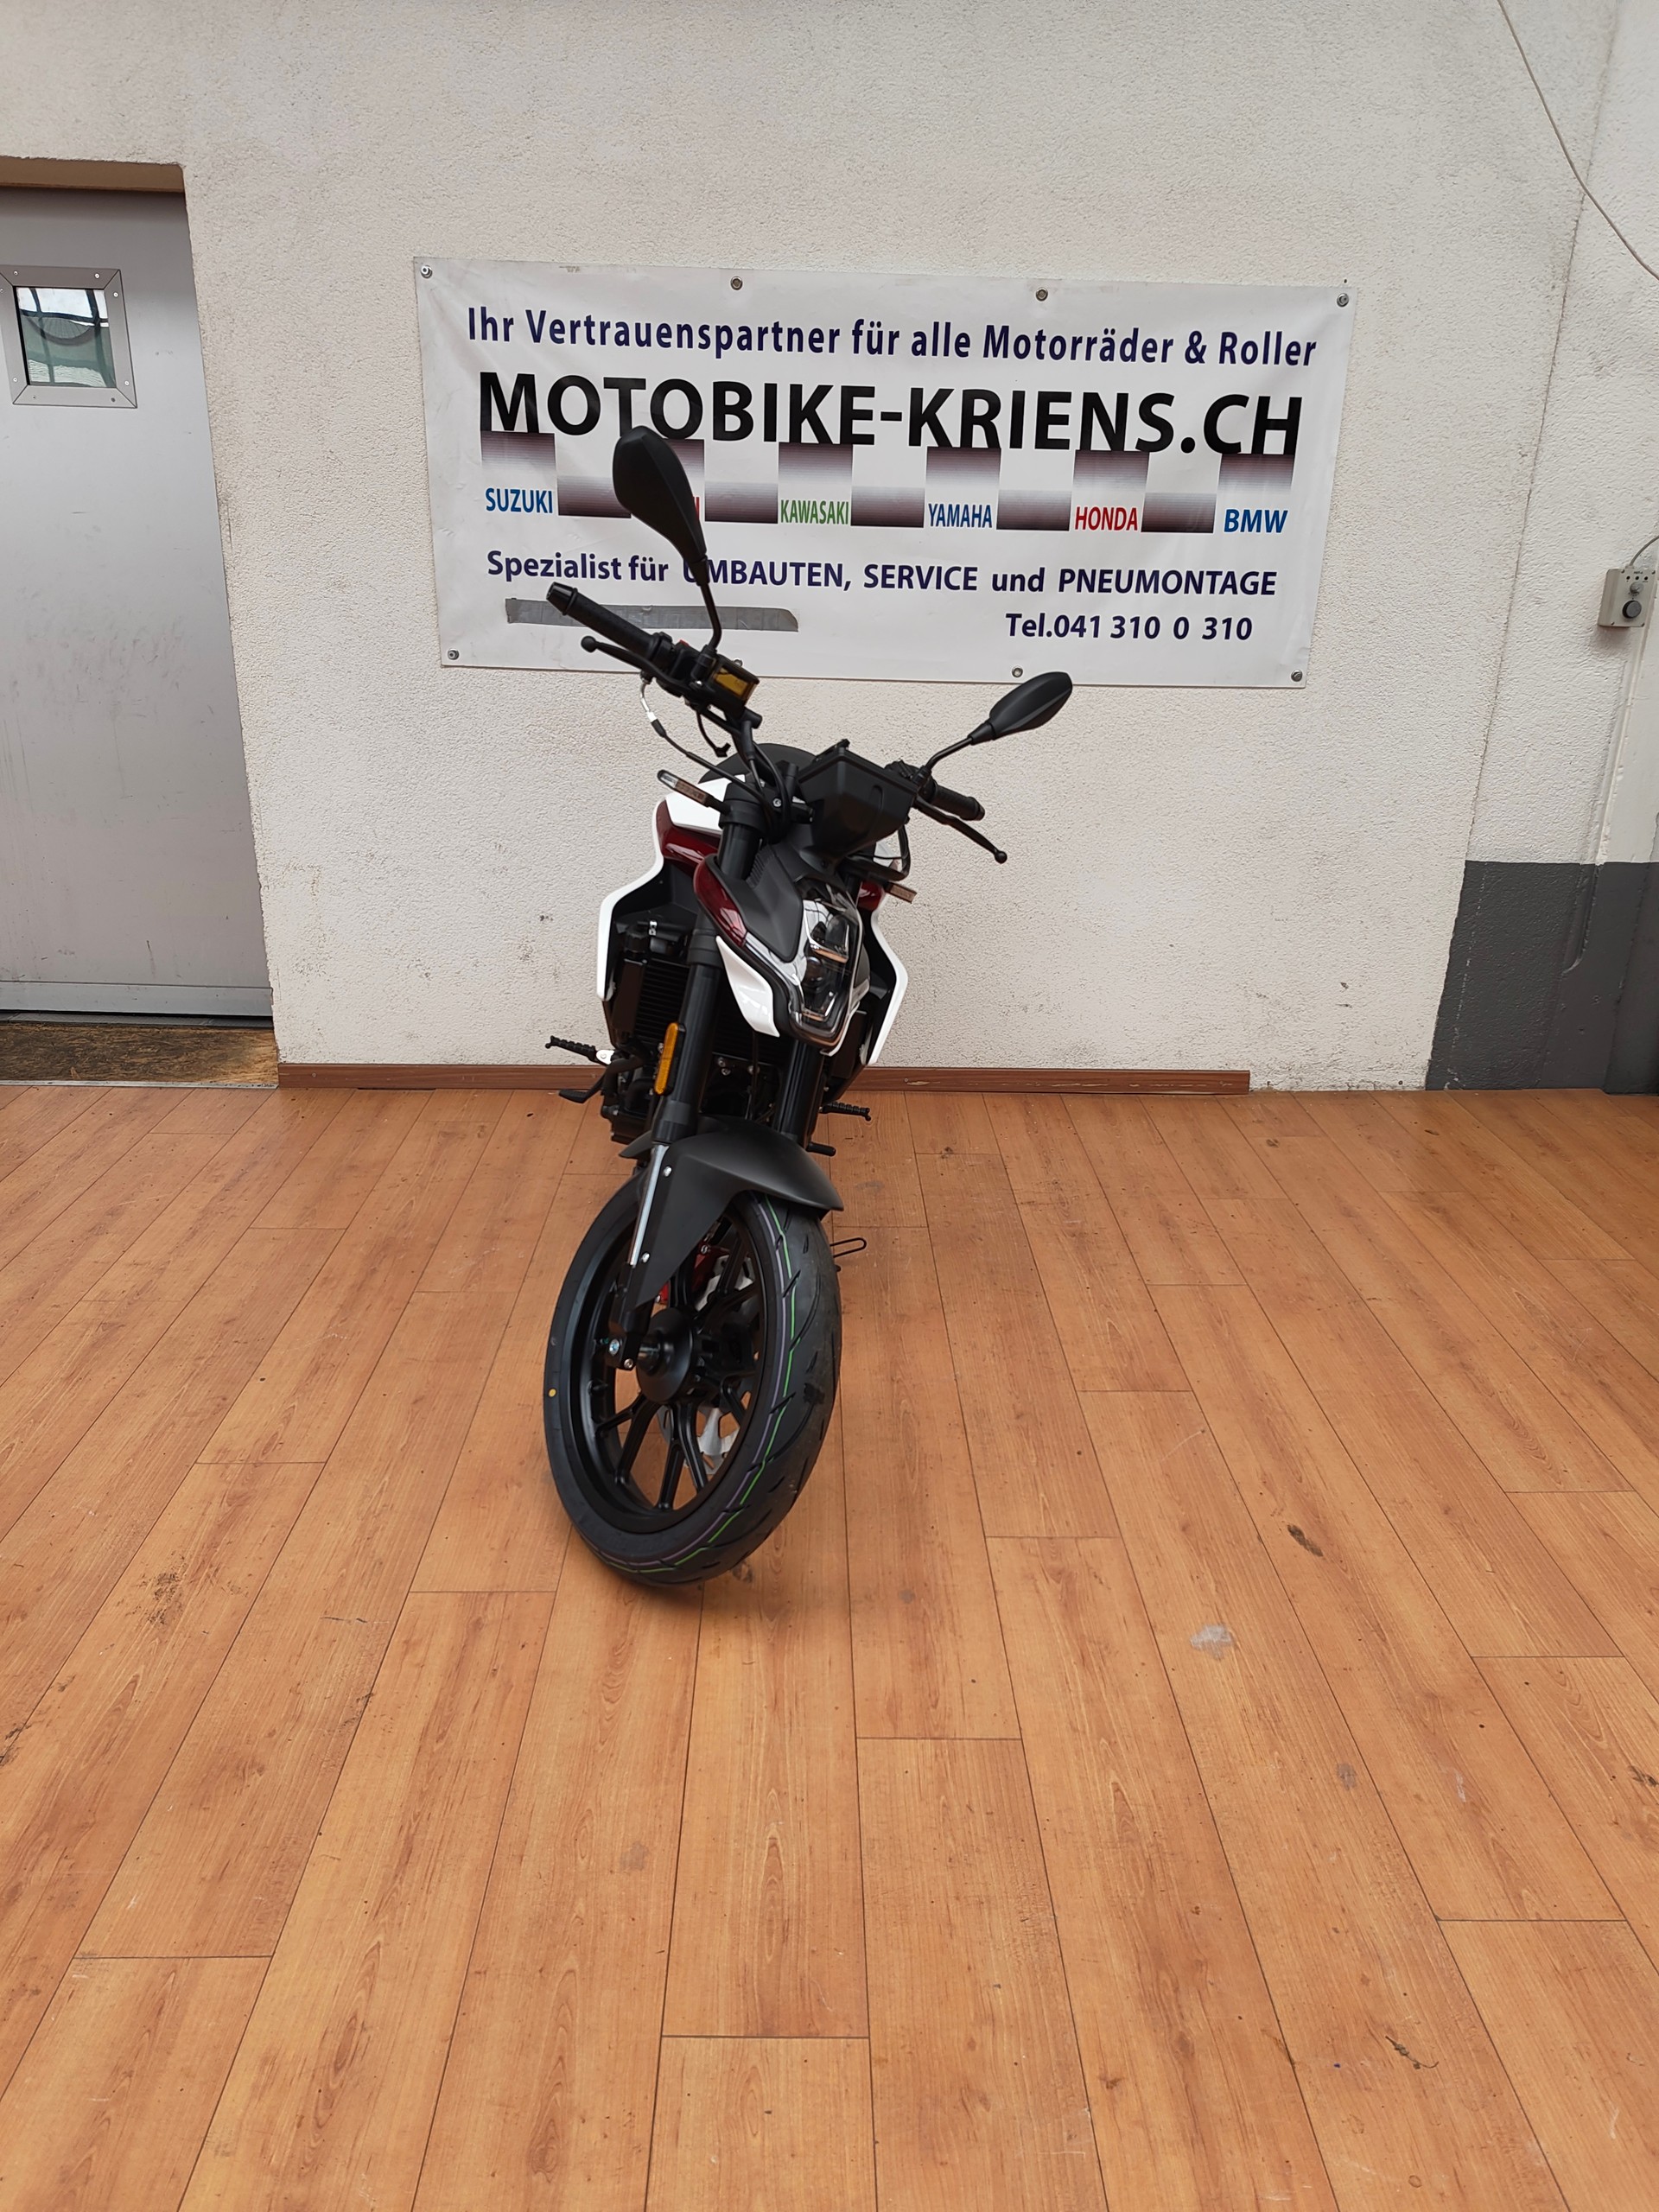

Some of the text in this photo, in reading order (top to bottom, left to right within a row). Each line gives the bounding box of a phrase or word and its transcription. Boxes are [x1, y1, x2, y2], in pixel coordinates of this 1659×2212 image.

[469, 307, 1316, 366] Ihr Vertrauenspartner für alle Motorräder & Roller
[480, 372, 1303, 455] MOTOBIKE-KRIENS.CH
[485, 488, 553, 514] SUZUKI
[780, 500, 849, 525] KAWASAKI
[928, 504, 993, 529] YAMAHA
[1075, 507, 1138, 531] HONDA
[1224, 509, 1288, 533] BMW
[488, 550, 621, 582] Spezialist
[628, 556, 669, 582] für
[864, 564, 978, 591] SERVICE
[992, 567, 1045, 592] und
[1058, 569, 1278, 595] PNEUMONTAGE
[1110, 616, 1160, 639] 310
[1173, 617, 1190, 640] 0
[1202, 617, 1253, 640] 310
